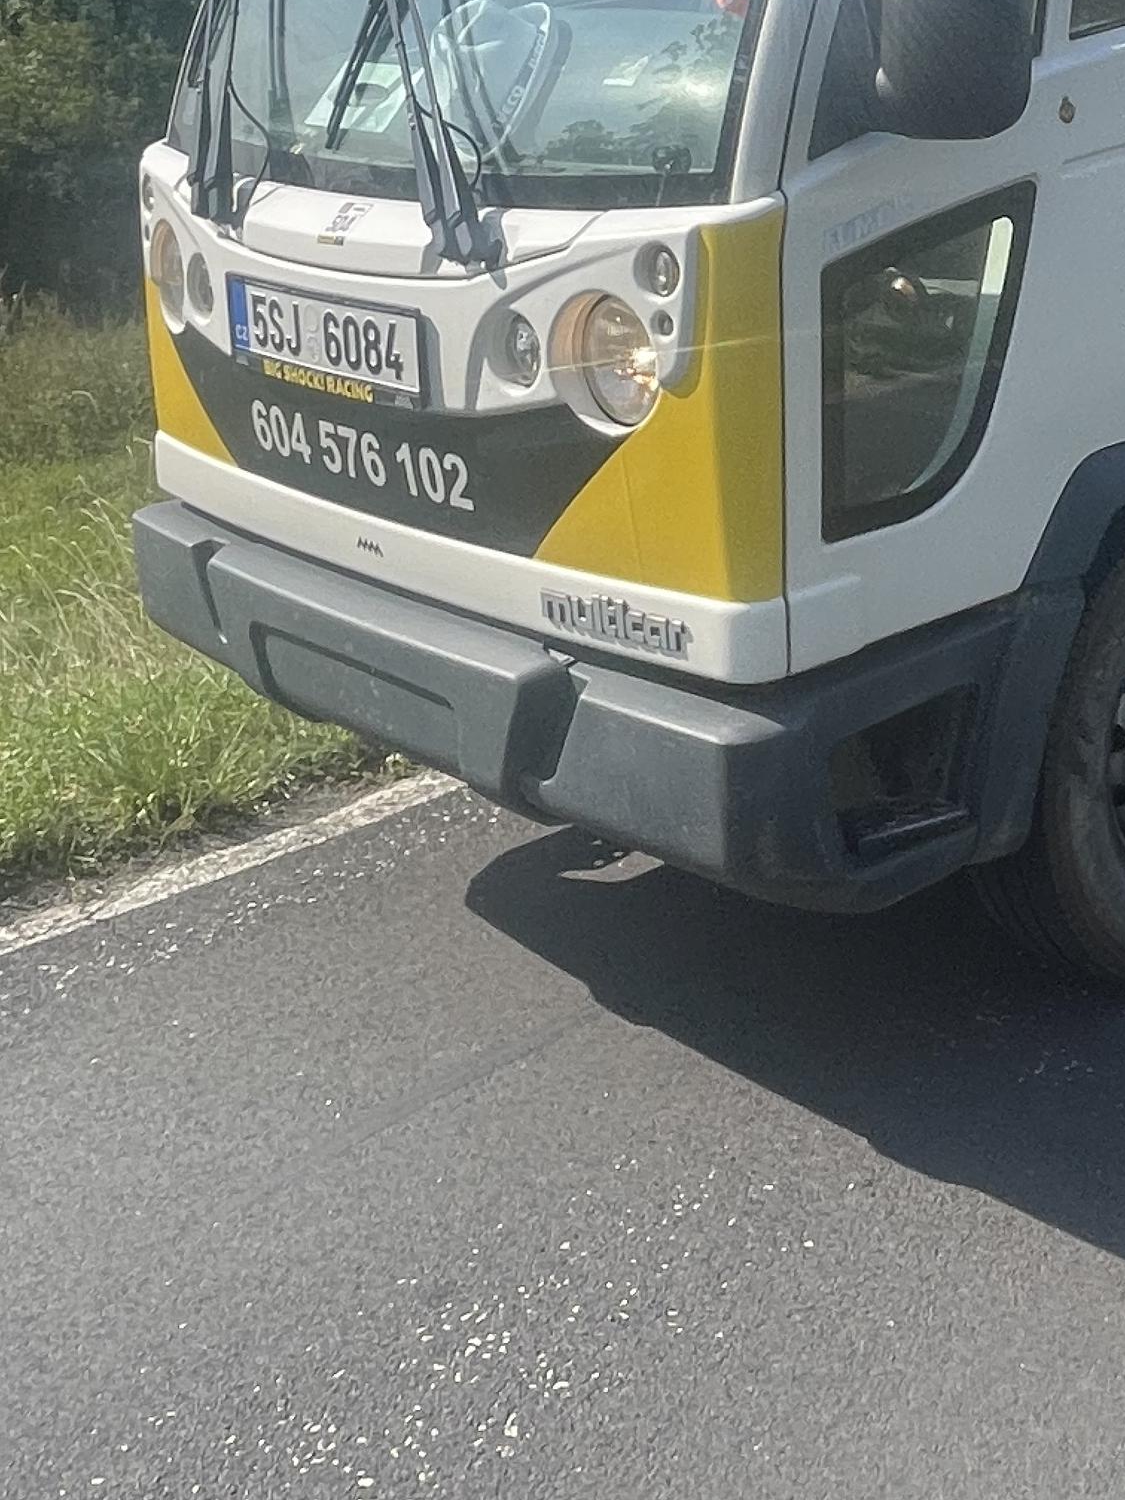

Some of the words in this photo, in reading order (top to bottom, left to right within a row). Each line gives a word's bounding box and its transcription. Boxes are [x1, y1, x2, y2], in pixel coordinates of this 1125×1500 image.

[235, 323, 248, 341] CZ
[251, 293, 301, 357] 5SJ
[323, 309, 404, 381] 6084
[251, 399, 312, 465] 604
[318, 419, 387, 488] 576
[395, 442, 475, 512] 102
[539, 588, 689, 656] multicar
